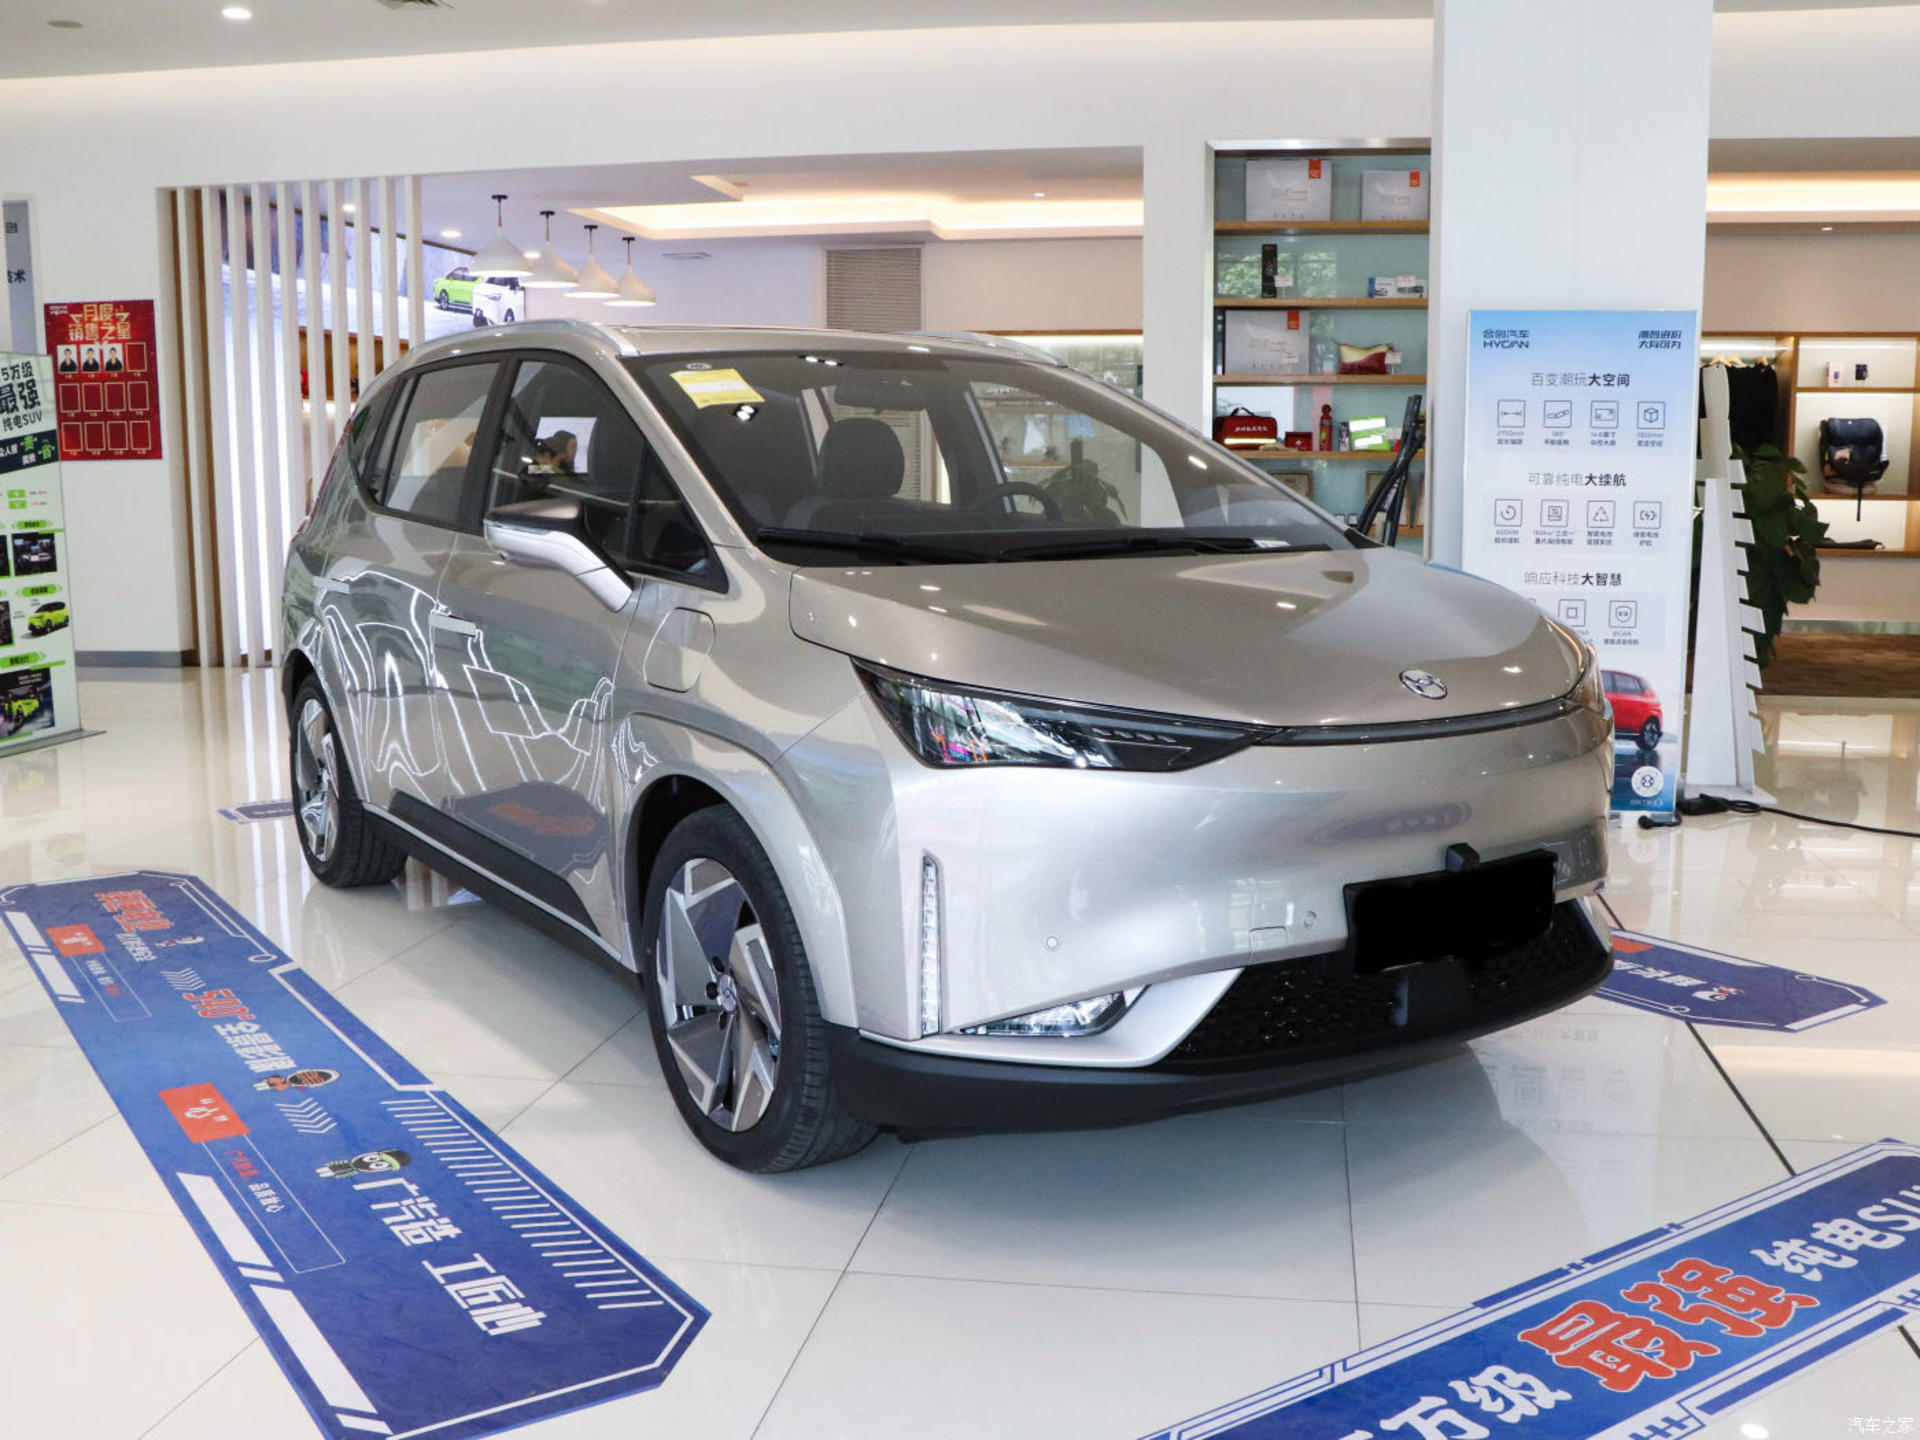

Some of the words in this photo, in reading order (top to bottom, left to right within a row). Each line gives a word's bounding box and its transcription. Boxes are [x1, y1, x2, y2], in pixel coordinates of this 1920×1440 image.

[83, 303, 114, 320] 月度
[68, 321, 132, 341] 销售之星
[1483, 340, 1529, 349] HYCAN
[1638, 340, 1682, 349] 大有可为
[1531, 373, 1631, 388] 百变潮玩大空间
[0, 378, 41, 414] 最强
[2, 410, 42, 432] 纯电SUV
[1528, 472, 1627, 487] 可靠纯电大续航
[1525, 572, 1624, 586] 响应科技大智慧
[353, 1178, 465, 1247] 广汽造
[422, 1252, 549, 1337] 工匠心
[1516, 1257, 1822, 1394] 最强
